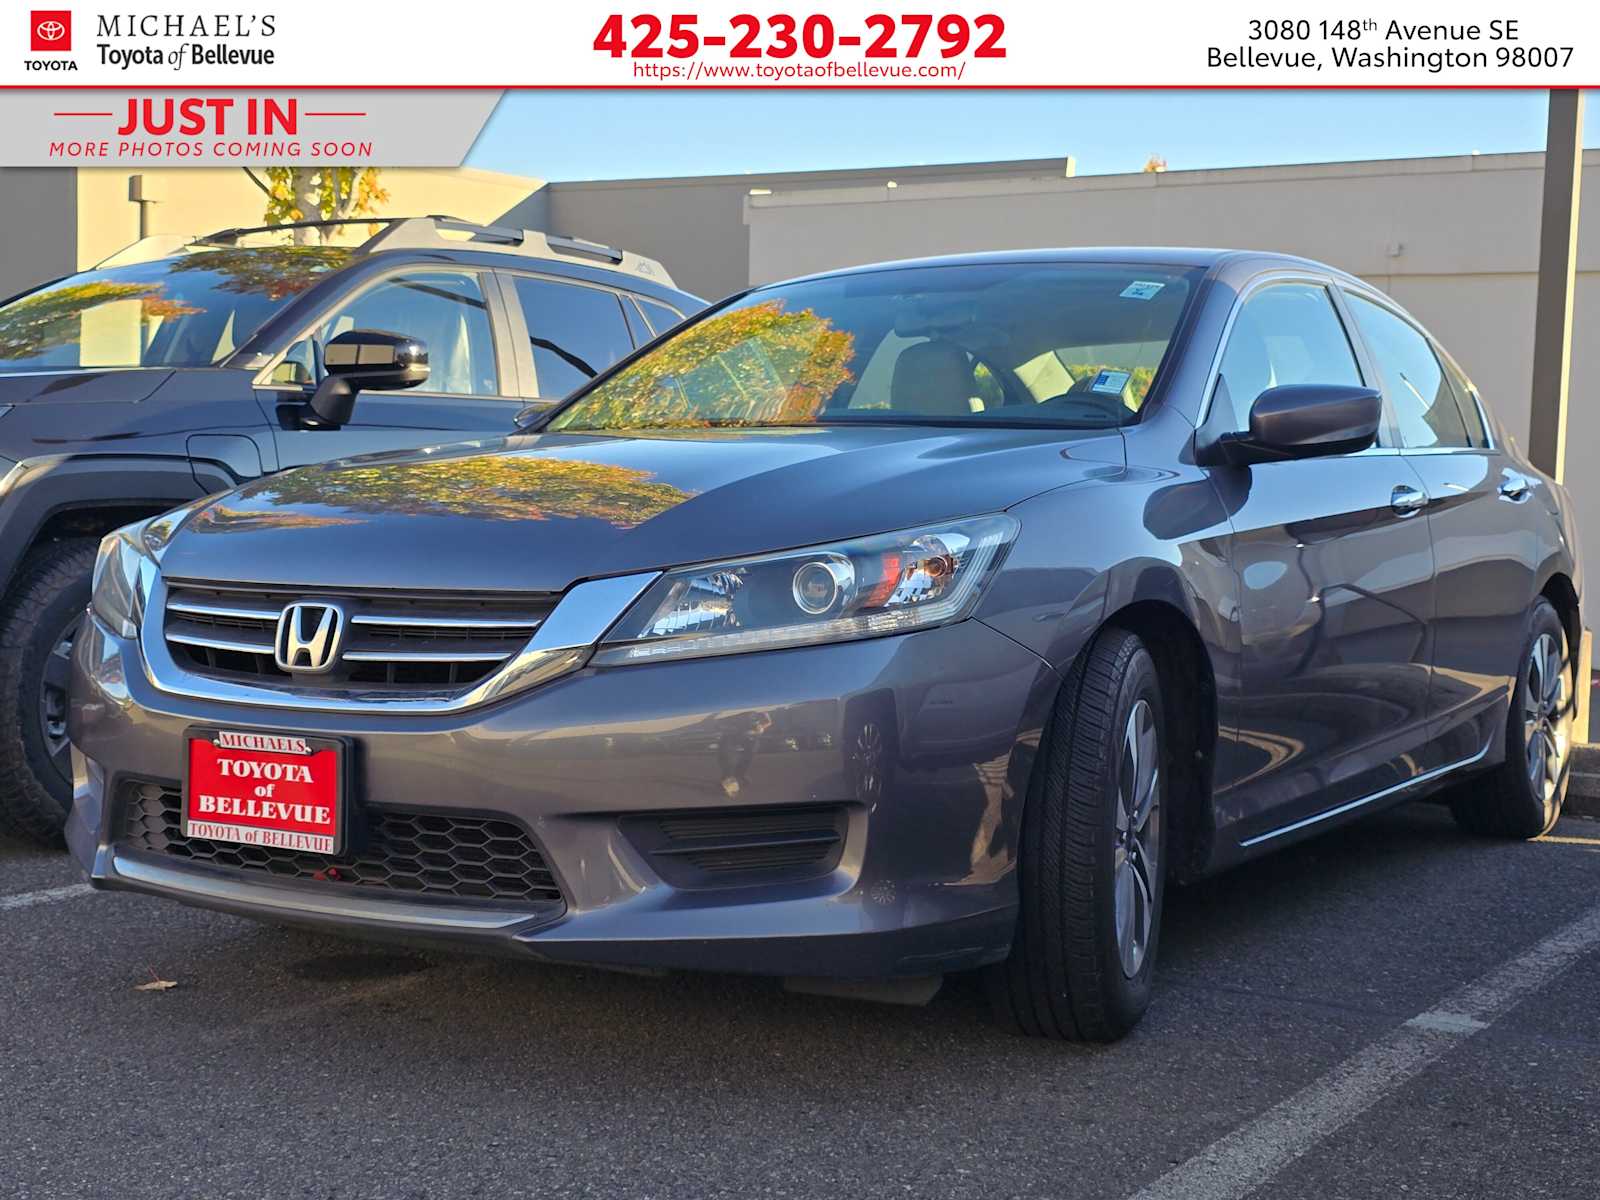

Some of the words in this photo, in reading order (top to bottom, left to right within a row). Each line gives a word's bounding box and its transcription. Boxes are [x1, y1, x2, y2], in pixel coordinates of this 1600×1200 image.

[217, 759, 313, 783] TOYOTA
[254, 784, 275, 798] of
[198, 795, 331, 825] BELLEVUE
[189, 822, 241, 842] TOYOTA
[244, 829, 259, 843] of
[263, 830, 333, 853] BELLEVUE
